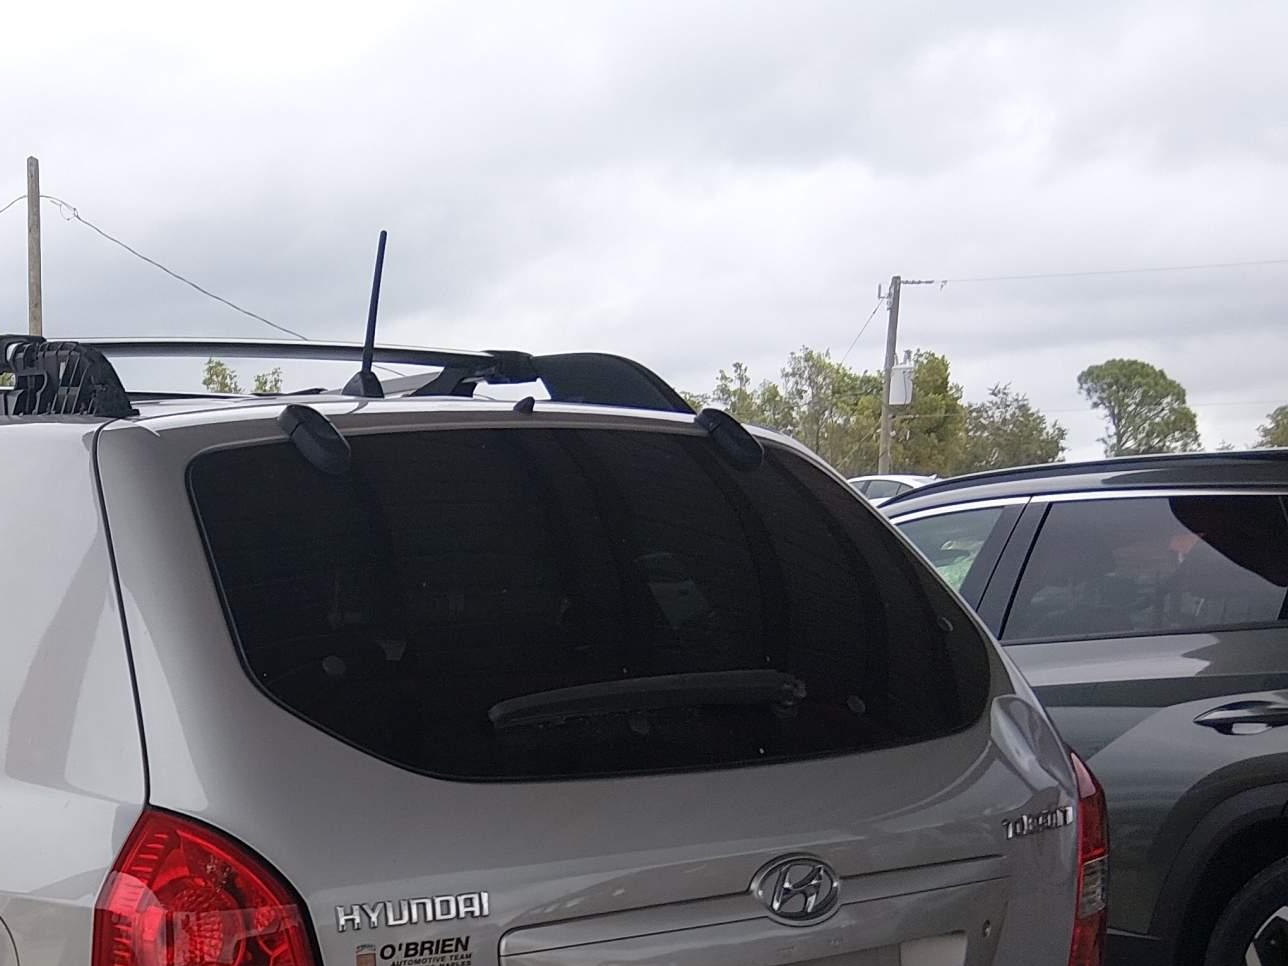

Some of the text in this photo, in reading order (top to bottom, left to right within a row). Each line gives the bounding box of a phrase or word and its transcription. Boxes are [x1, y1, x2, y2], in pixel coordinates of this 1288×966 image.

[336, 891, 489, 932] HYUNDAI
[379, 936, 470, 960] O'BRIEN
[449, 953, 472, 961] TEAM
